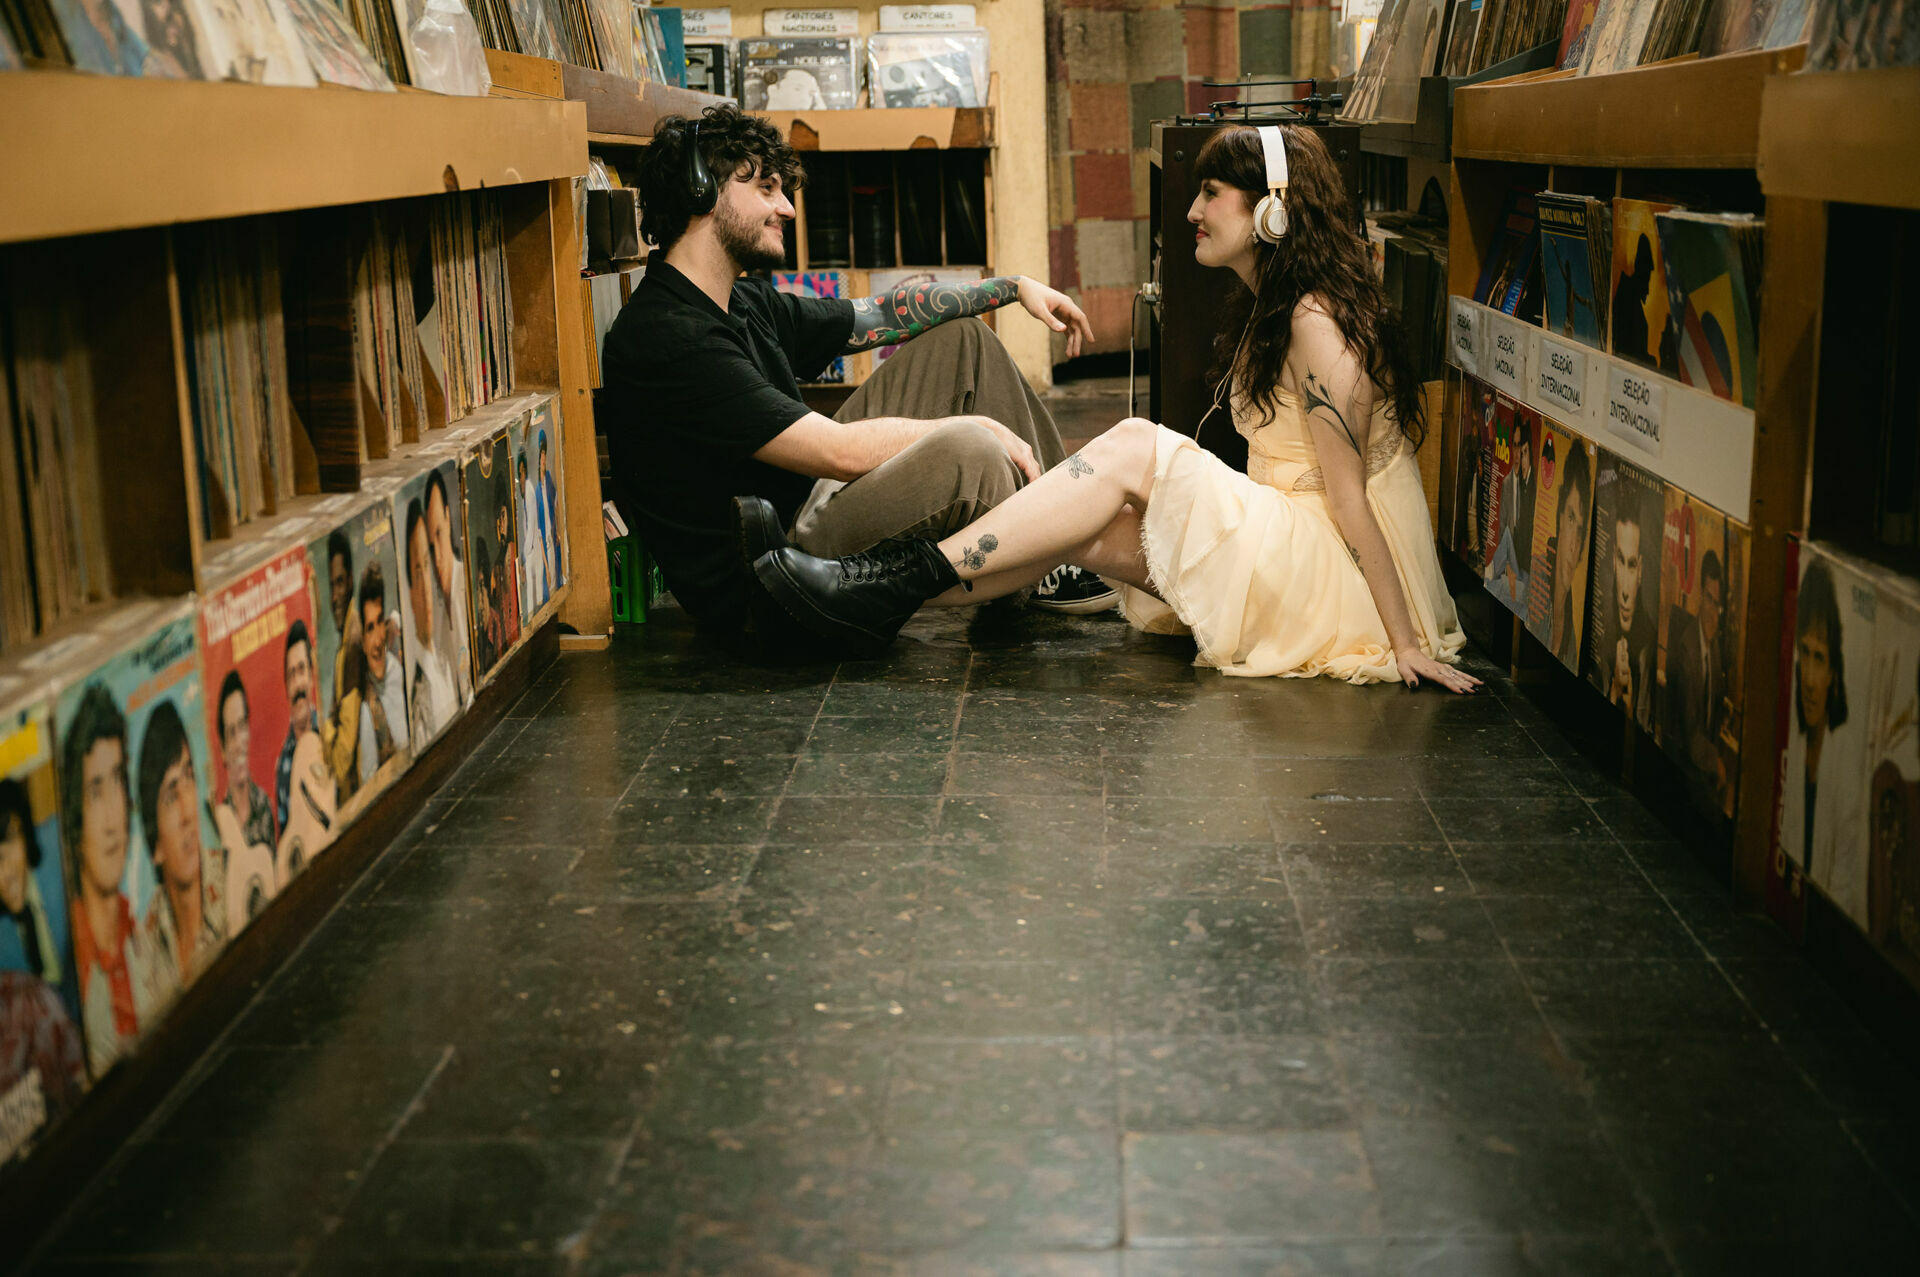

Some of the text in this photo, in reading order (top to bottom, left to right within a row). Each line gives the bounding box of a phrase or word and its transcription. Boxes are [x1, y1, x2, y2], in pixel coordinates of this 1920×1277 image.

[784, 12, 834, 20] CANTORES
[902, 11, 953, 20] CANTORES
[781, 24, 837, 33] NACIONAIS
[1497, 333, 1515, 355] SELEÇÃO
[1494, 356, 1516, 380] NACIONAL
[1551, 353, 1573, 376] SELEÇÃO
[1541, 373, 1581, 407] INTERNACIONAL
[1623, 378, 1650, 406] SELEÇÃO
[1609, 400, 1661, 442] INTERNACIONAL
